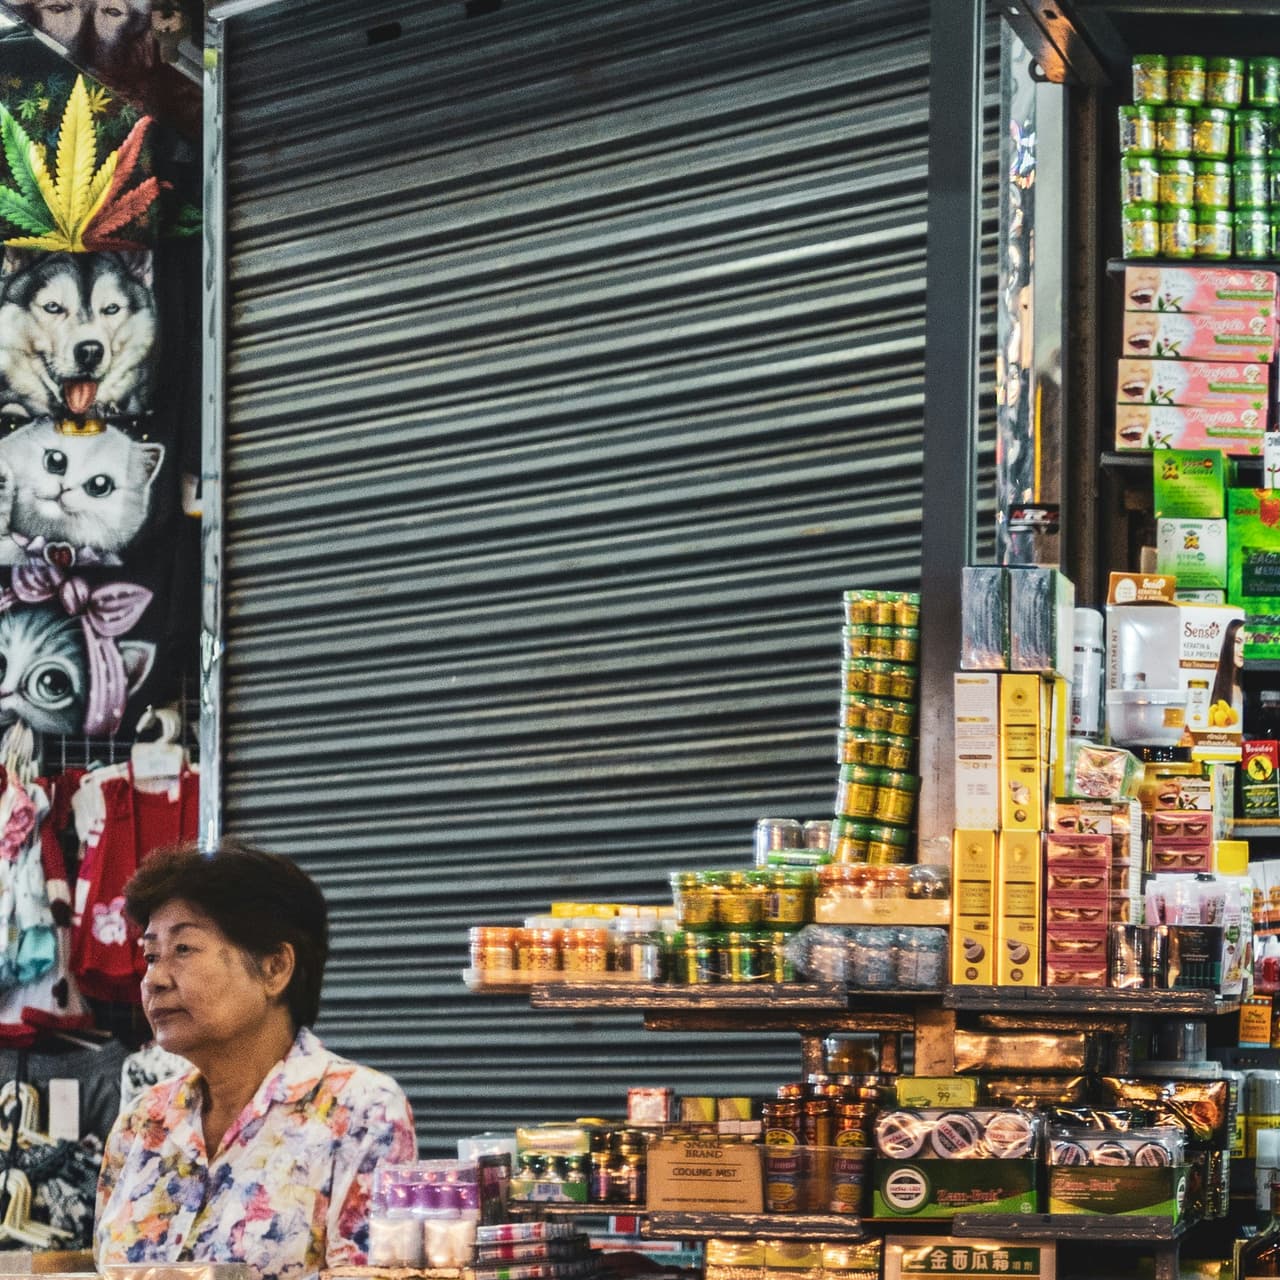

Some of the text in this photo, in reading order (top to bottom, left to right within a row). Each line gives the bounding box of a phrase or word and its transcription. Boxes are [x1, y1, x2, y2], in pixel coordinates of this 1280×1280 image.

[685, 1150, 723, 1158] BRAND
[672, 1167, 738, 1178] COOLING MIST
